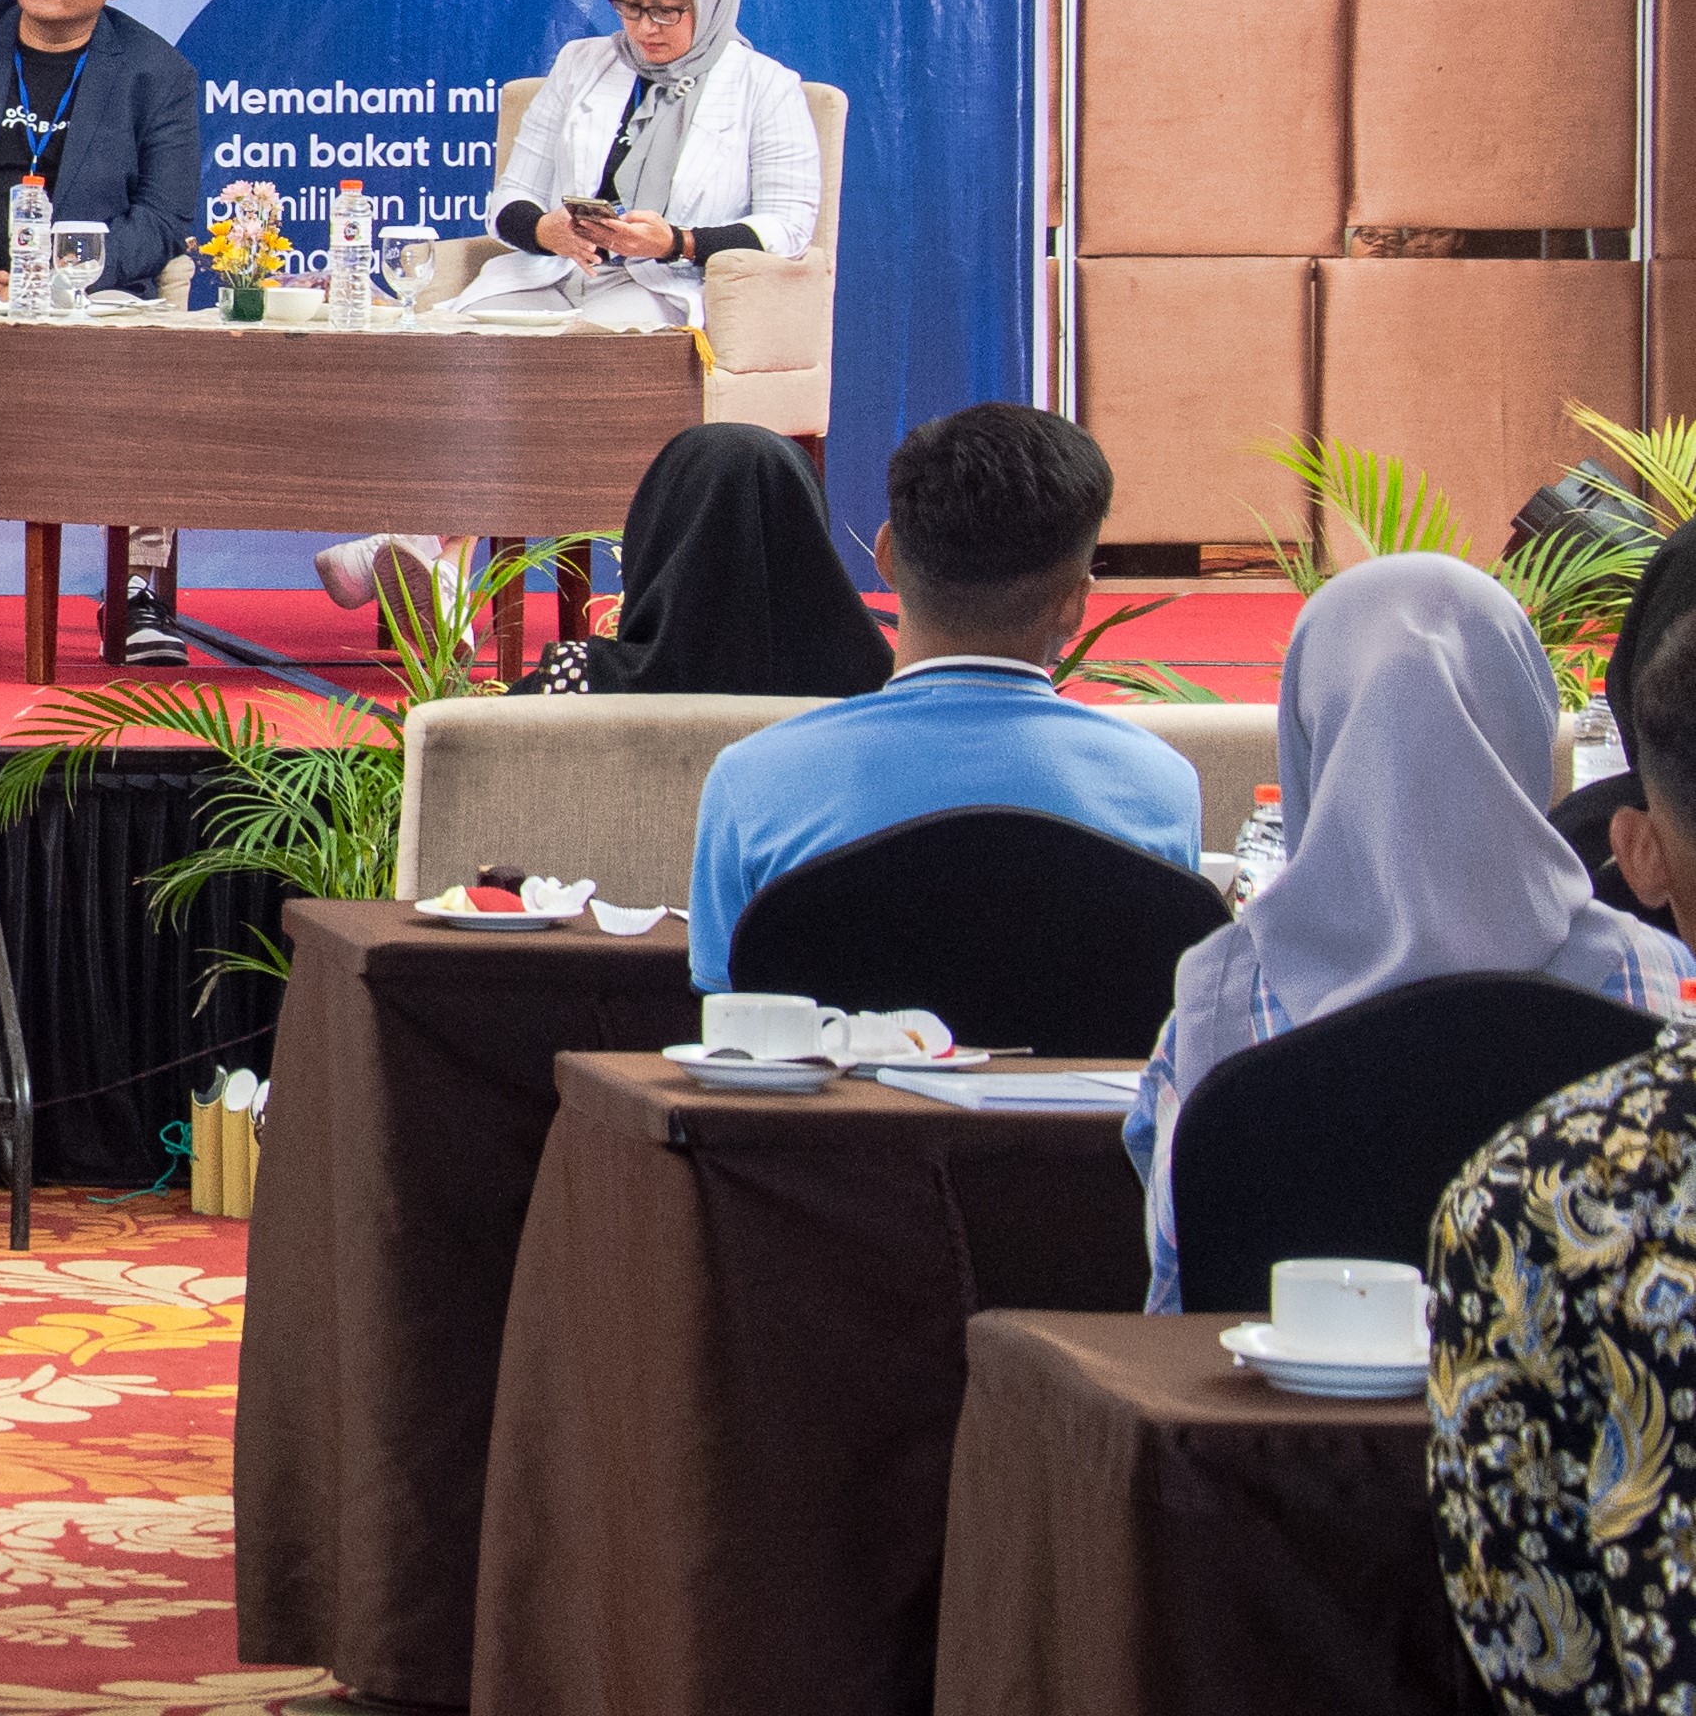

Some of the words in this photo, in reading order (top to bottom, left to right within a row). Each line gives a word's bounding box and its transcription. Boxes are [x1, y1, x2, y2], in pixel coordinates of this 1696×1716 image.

[205, 79, 436, 115] Memahami
[214, 134, 297, 168] dan
[310, 134, 430, 168] bakat
[417, 186, 491, 227] juru
